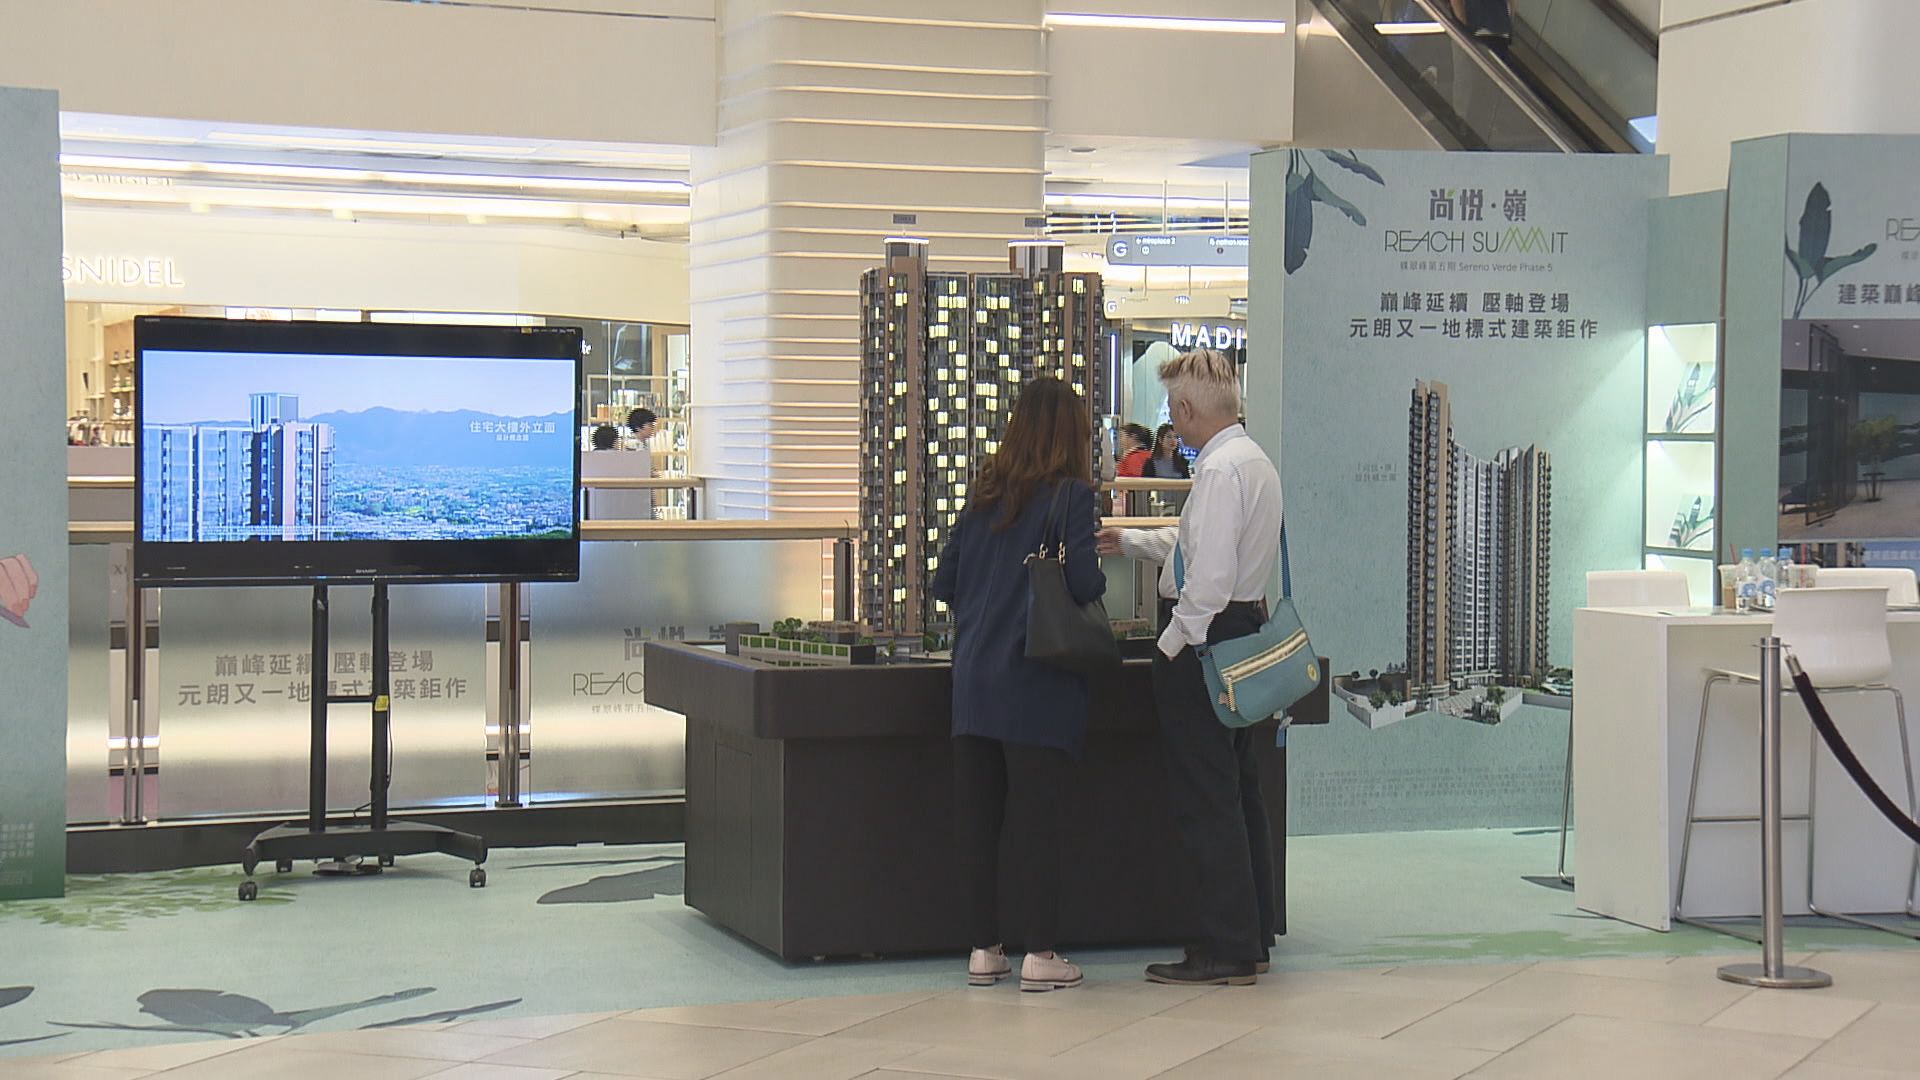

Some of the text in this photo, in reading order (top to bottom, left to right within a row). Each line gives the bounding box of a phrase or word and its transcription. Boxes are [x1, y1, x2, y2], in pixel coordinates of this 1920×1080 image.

[1113, 241, 1128, 257] G
[1384, 226, 1569, 254] REACH SUMMIT
[1492, 262, 1517, 272] Verde
[1520, 262, 1545, 272] Phase
[1482, 292, 1569, 313] 壓軸登場
[1350, 318, 1598, 339] 元朗又一地標式建築鉅作
